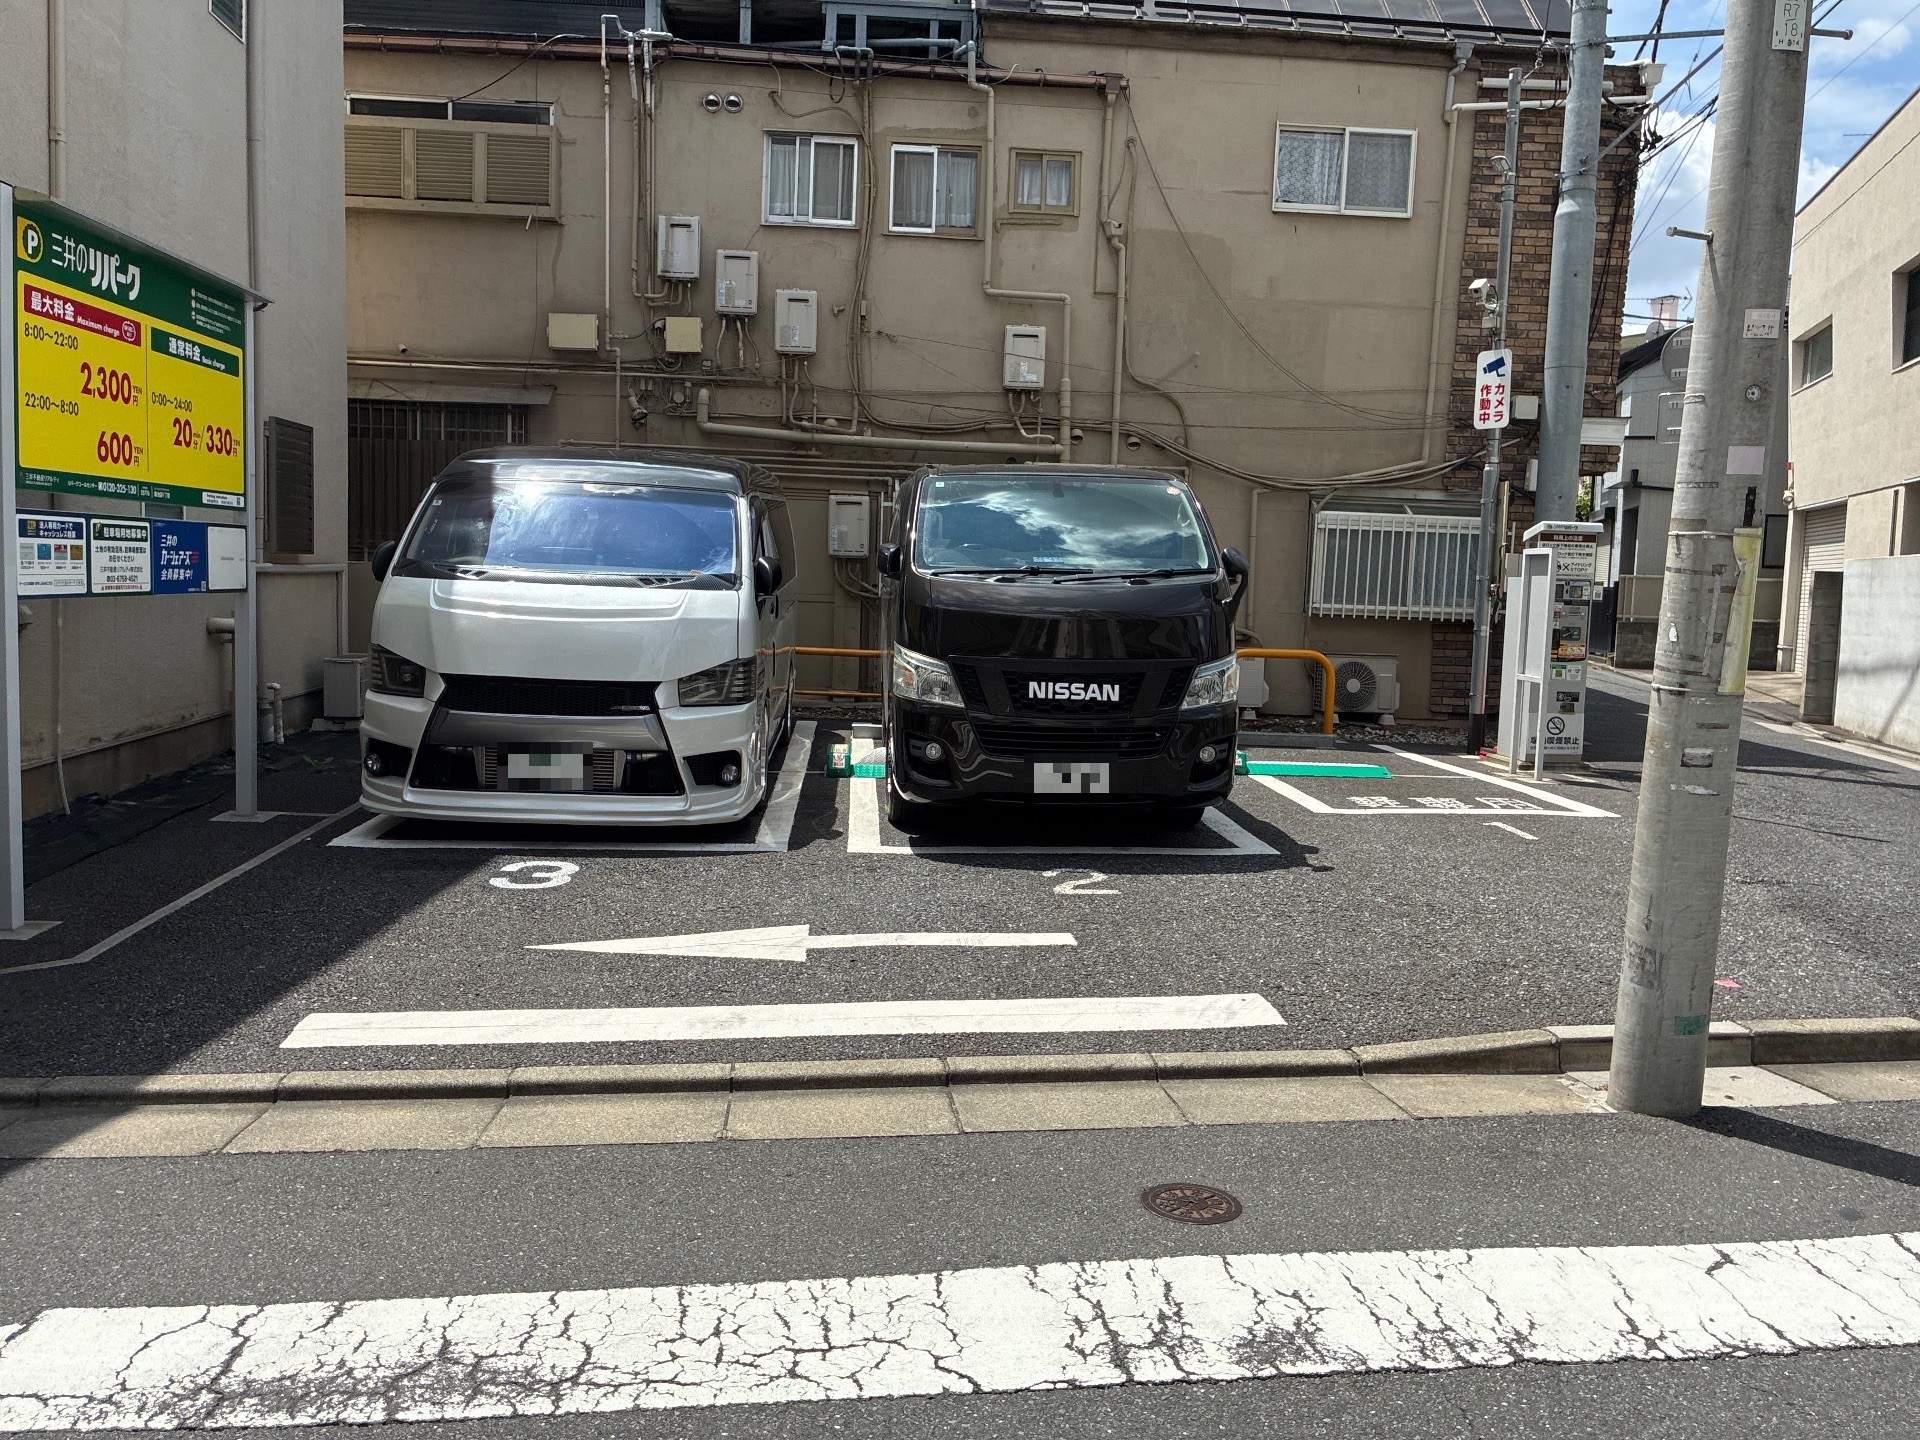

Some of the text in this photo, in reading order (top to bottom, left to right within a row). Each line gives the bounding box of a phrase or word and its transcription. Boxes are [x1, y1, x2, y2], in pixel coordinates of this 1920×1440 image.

[1784, 22, 1798, 37] 18
[27, 229, 39, 255] P
[51, 232, 141, 301] 三井のリパーク
[31, 290, 75, 322] 最大料金
[77, 315, 102, 331] Maximum
[103, 323, 120, 338] charge
[168, 336, 201, 362] 通常料金
[201, 355, 226, 371] Basic charge
[80, 361, 132, 406] 2,300
[132, 385, 143, 395] YEN
[132, 395, 139, 407] 円
[1479, 384, 1492, 424] 作動中
[1494, 383, 1505, 423] カメラ
[172, 416, 193, 449] 20
[205, 424, 233, 457] 330
[97, 430, 133, 466] 600
[133, 445, 144, 455] YEN
[133, 455, 140, 467] 円
[103, 526, 147, 540] 駐車場用地募集中
[160, 534, 178, 548] 三井の
[1028, 681, 1120, 702] NISSAN
[488, 860, 580, 889] 3
[1041, 868, 1122, 895] 2
